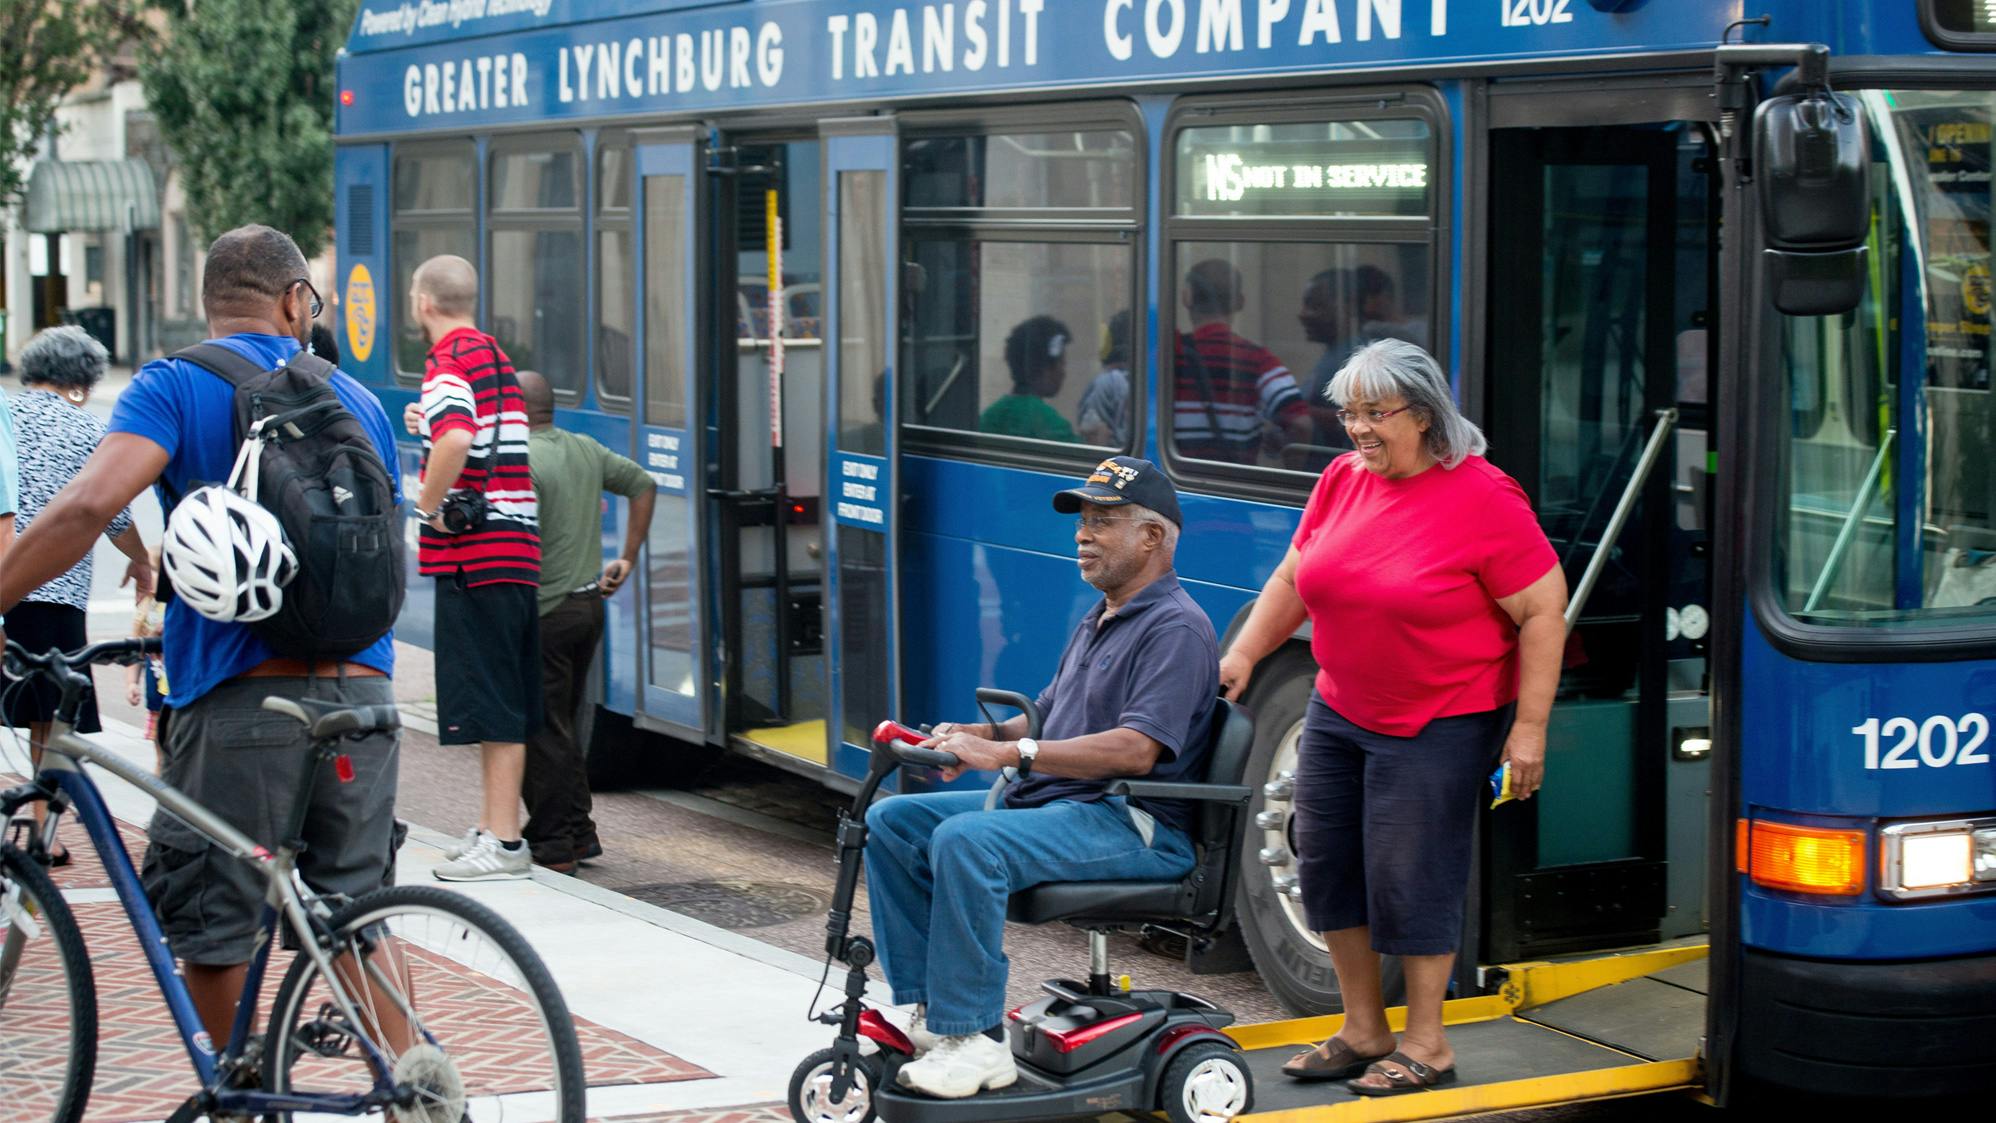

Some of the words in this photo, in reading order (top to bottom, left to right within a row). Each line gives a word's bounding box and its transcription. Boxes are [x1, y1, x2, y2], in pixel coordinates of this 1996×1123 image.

[404, 53, 528, 117] GREATER
[559, 21, 785, 103] LYNCHBURG
[828, 0, 1044, 80] TRANSIT
[1243, 166, 1287, 188] NOT
[1293, 165, 1322, 188] IN
[1327, 164, 1428, 188] SERVICE
[1852, 712, 1990, 770] 1202
